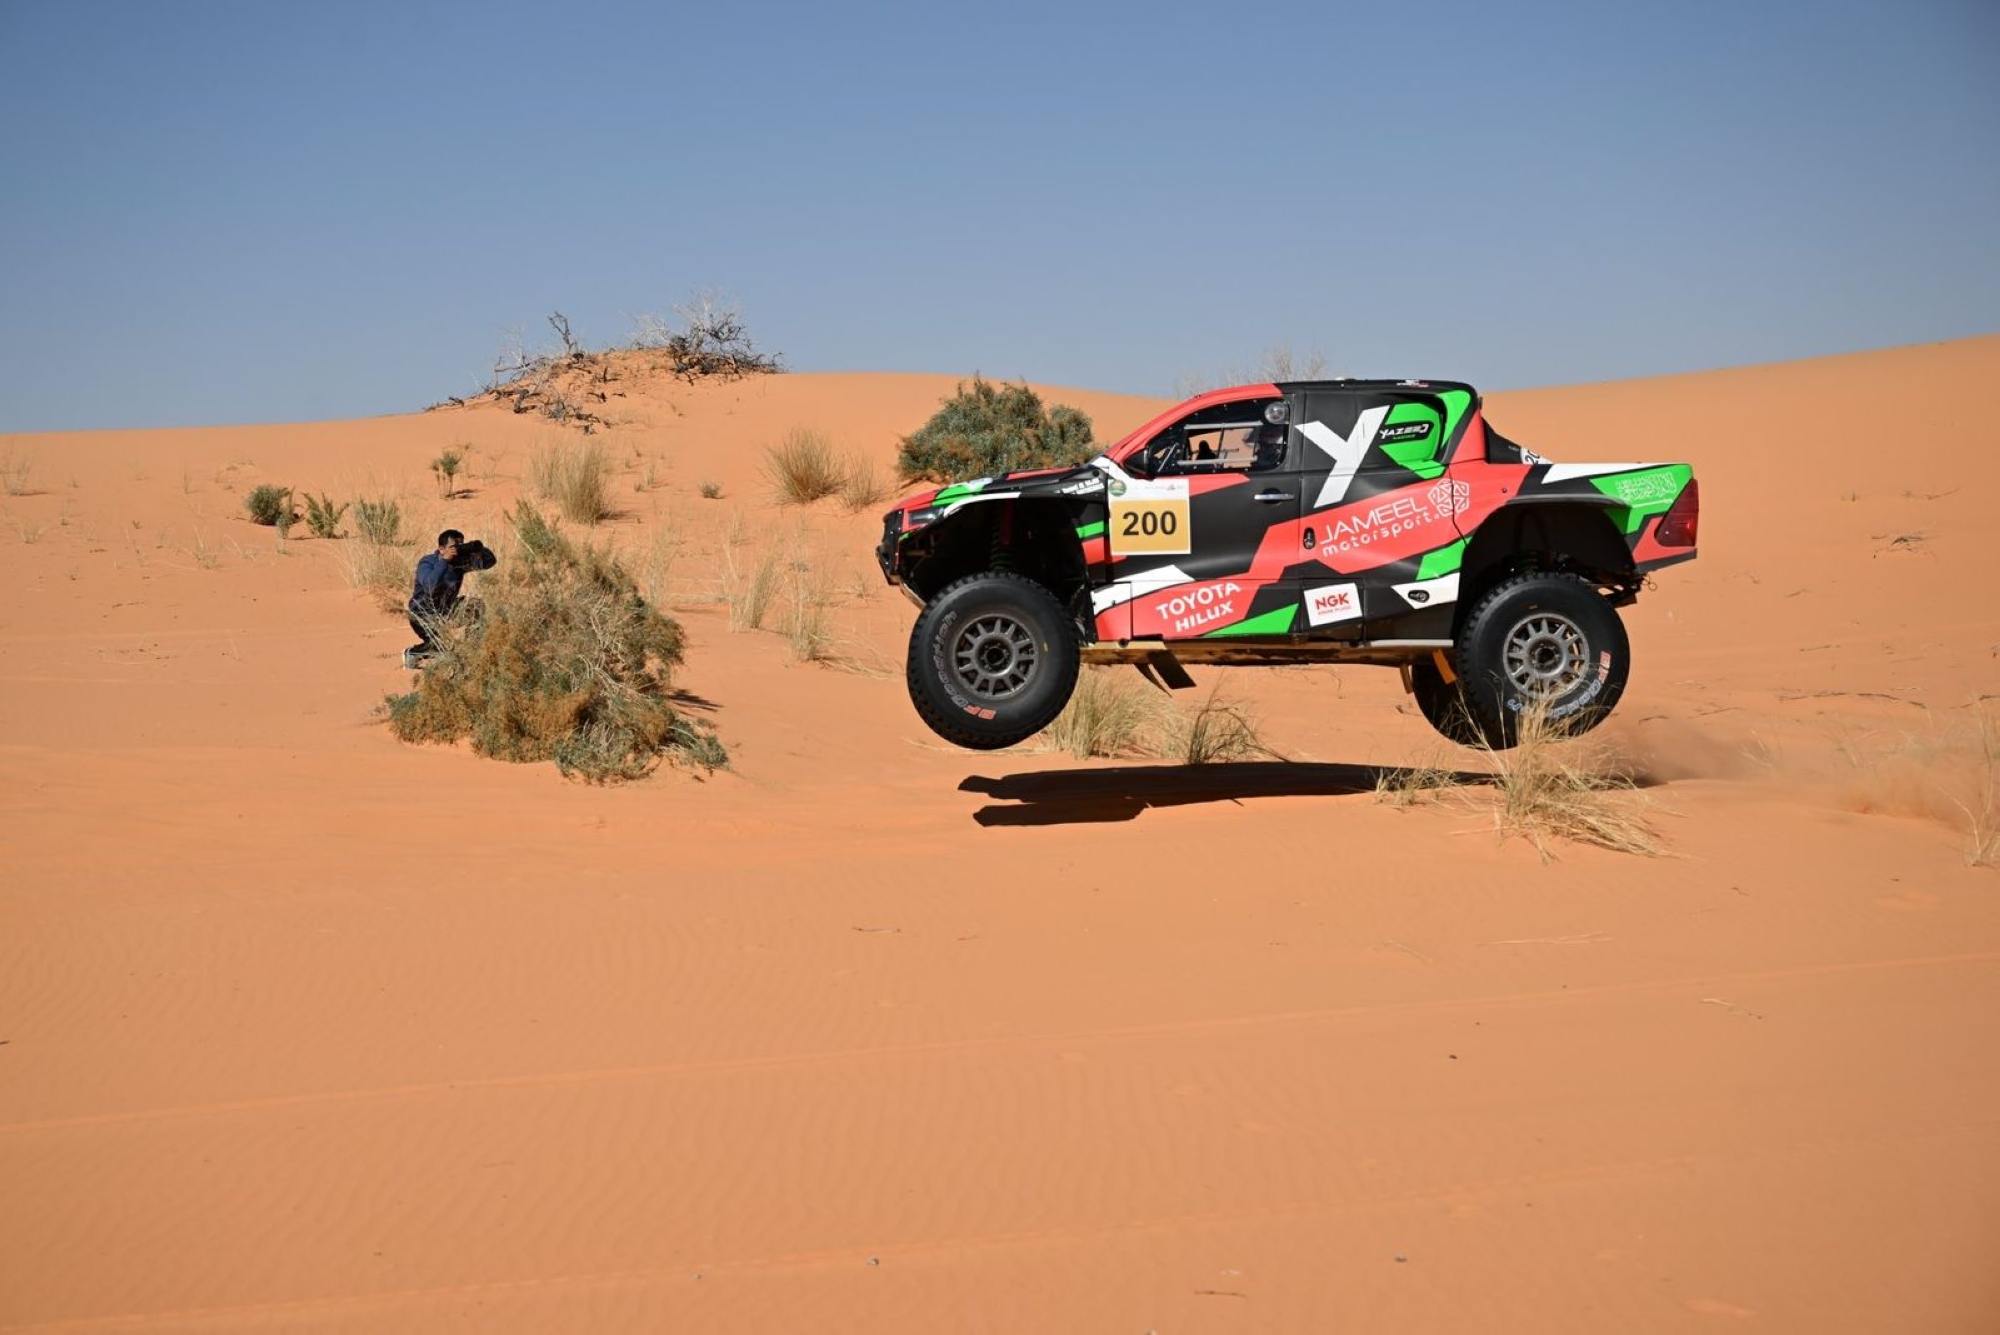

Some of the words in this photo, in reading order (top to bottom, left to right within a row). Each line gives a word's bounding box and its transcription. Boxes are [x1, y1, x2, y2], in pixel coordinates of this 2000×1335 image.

[1294, 404, 1391, 509] Y
[1122, 511, 1177, 536] 200
[1320, 497, 1429, 545] JAMEEL
[1155, 582, 1241, 620] TOYOTA
[1174, 600, 1234, 633] HILUX
[1315, 592, 1349, 610] NGK
